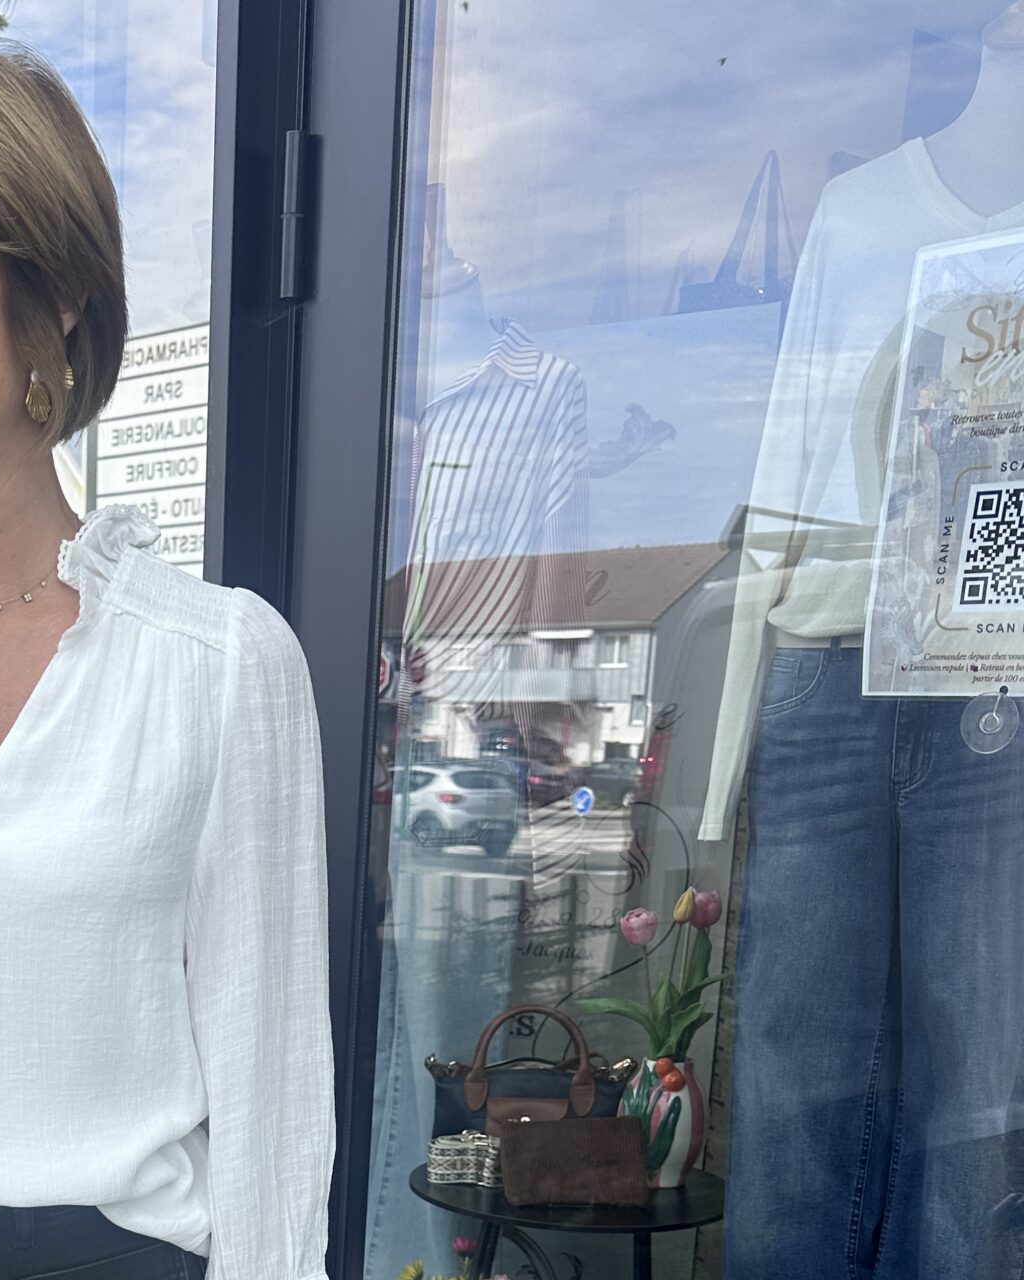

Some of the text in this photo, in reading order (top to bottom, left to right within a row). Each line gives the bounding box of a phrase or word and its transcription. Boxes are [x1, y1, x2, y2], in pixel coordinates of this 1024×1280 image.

[951, 409, 1023, 425] Retrouvez toutes
[970, 426, 1008, 438] boutique
[936, 515, 955, 585] SCAN ME
[976, 622, 1016, 634] SCAN
[924, 652, 967, 661] Commandez
[968, 652, 991, 662] depuis
[991, 652, 1007, 660] chez
[910, 663, 940, 672] Livraison
[942, 663, 965, 673] rapide
[980, 663, 1004, 672] Retrait
[972, 675, 994, 684] partir
[994, 674, 1003, 682] de
